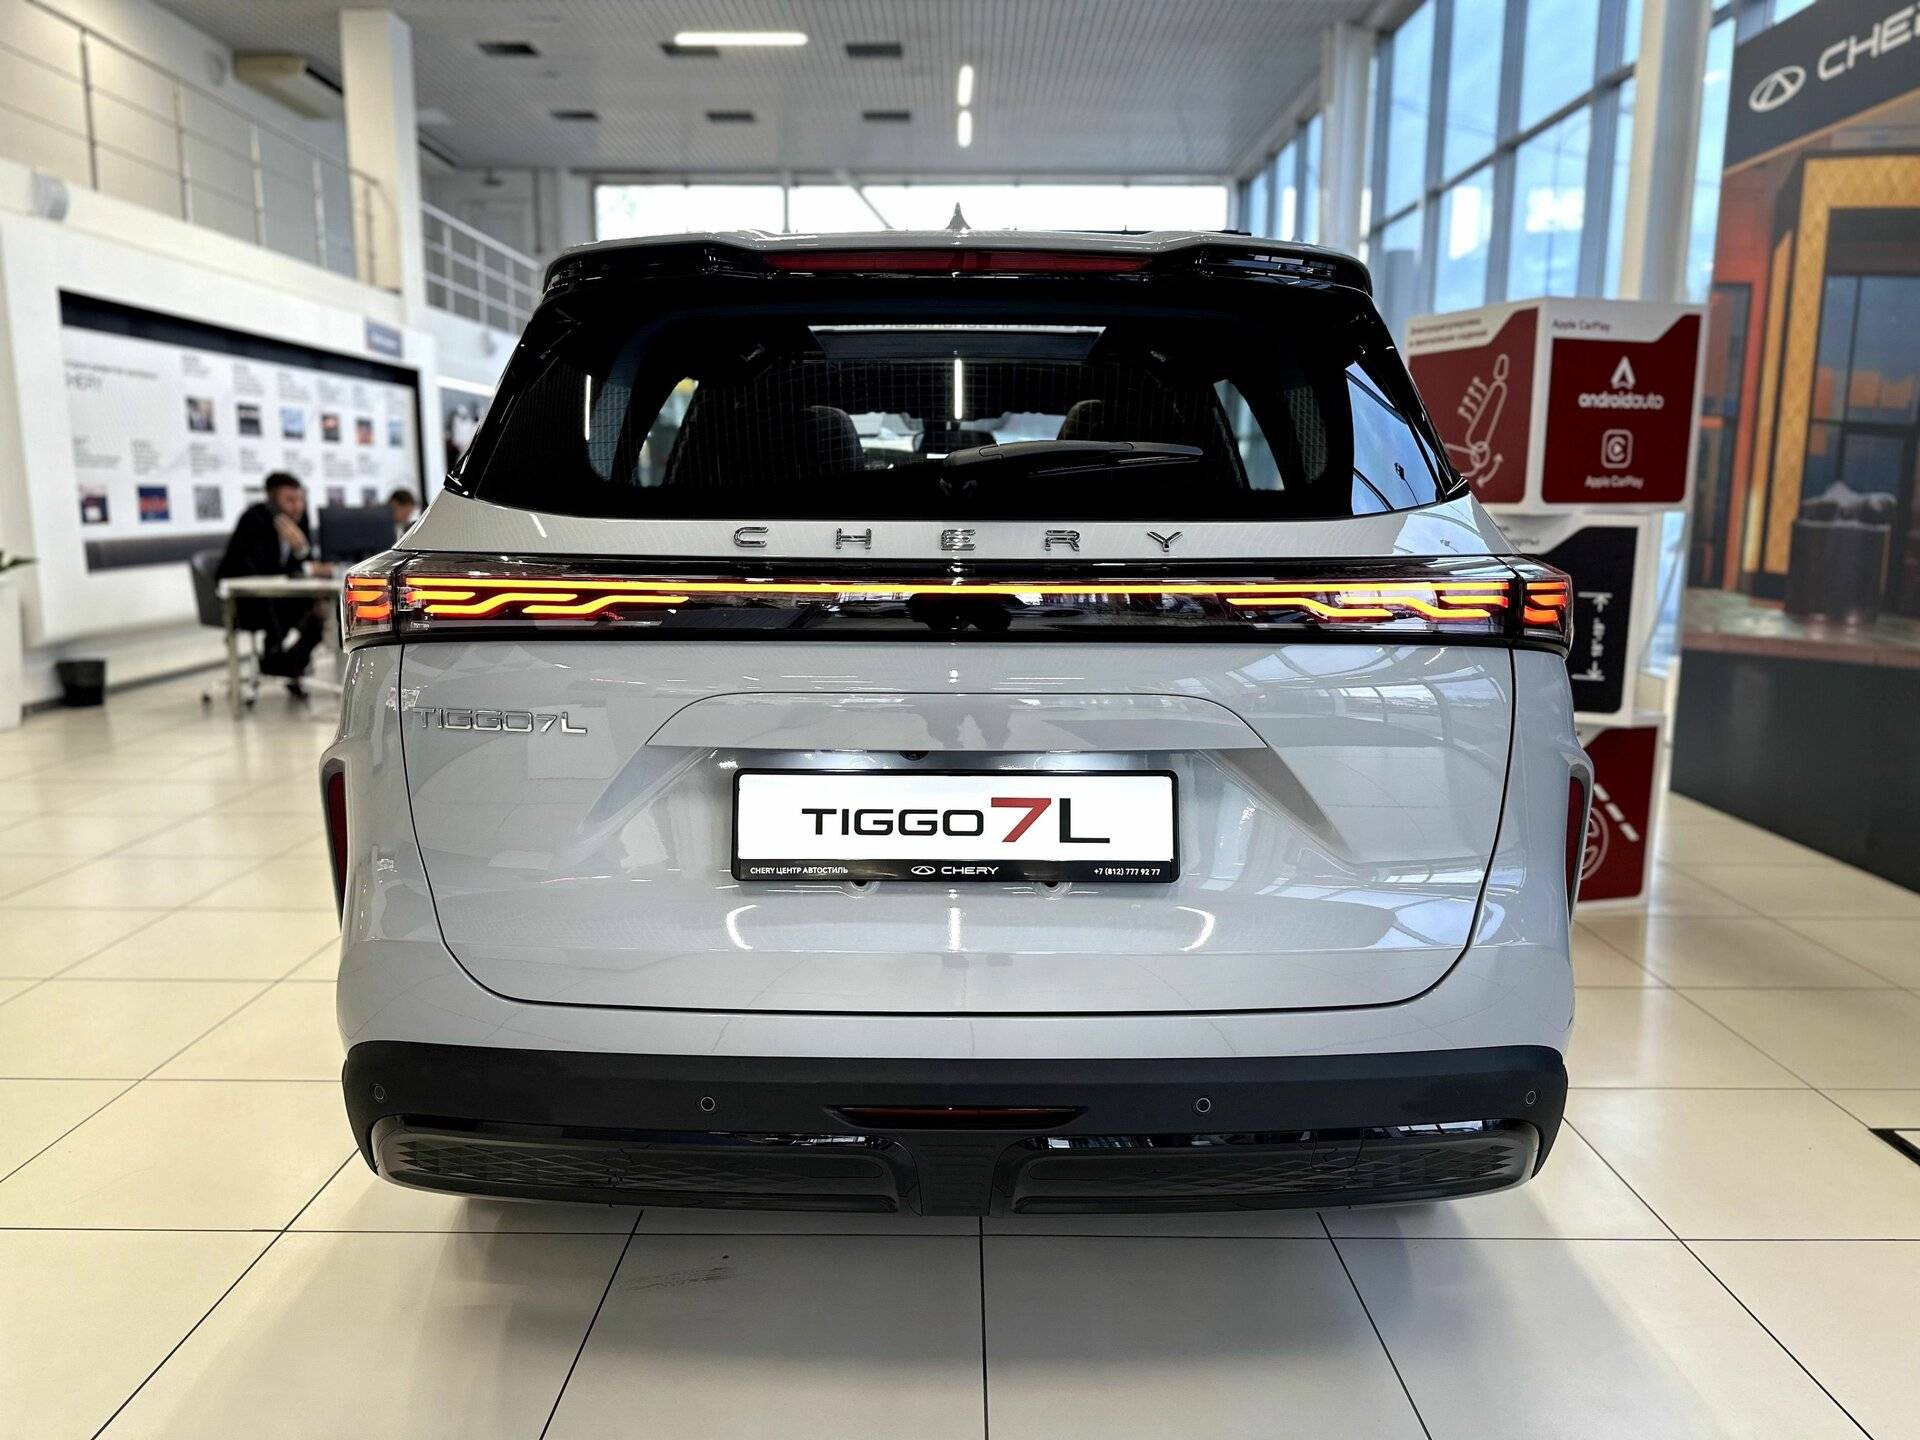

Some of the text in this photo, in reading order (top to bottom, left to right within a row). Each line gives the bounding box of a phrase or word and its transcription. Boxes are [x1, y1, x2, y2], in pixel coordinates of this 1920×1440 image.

[1817, 1, 1920, 81] CHE
[733, 526, 1183, 552] CHERY
[776, 867, 801, 875] ЦЕНТР
[803, 866, 849, 874] АВТОСТИЛЬ
[941, 866, 1000, 875] CHERY
[1094, 867, 1104, 875] +7
[1105, 867, 1124, 876] (812)
